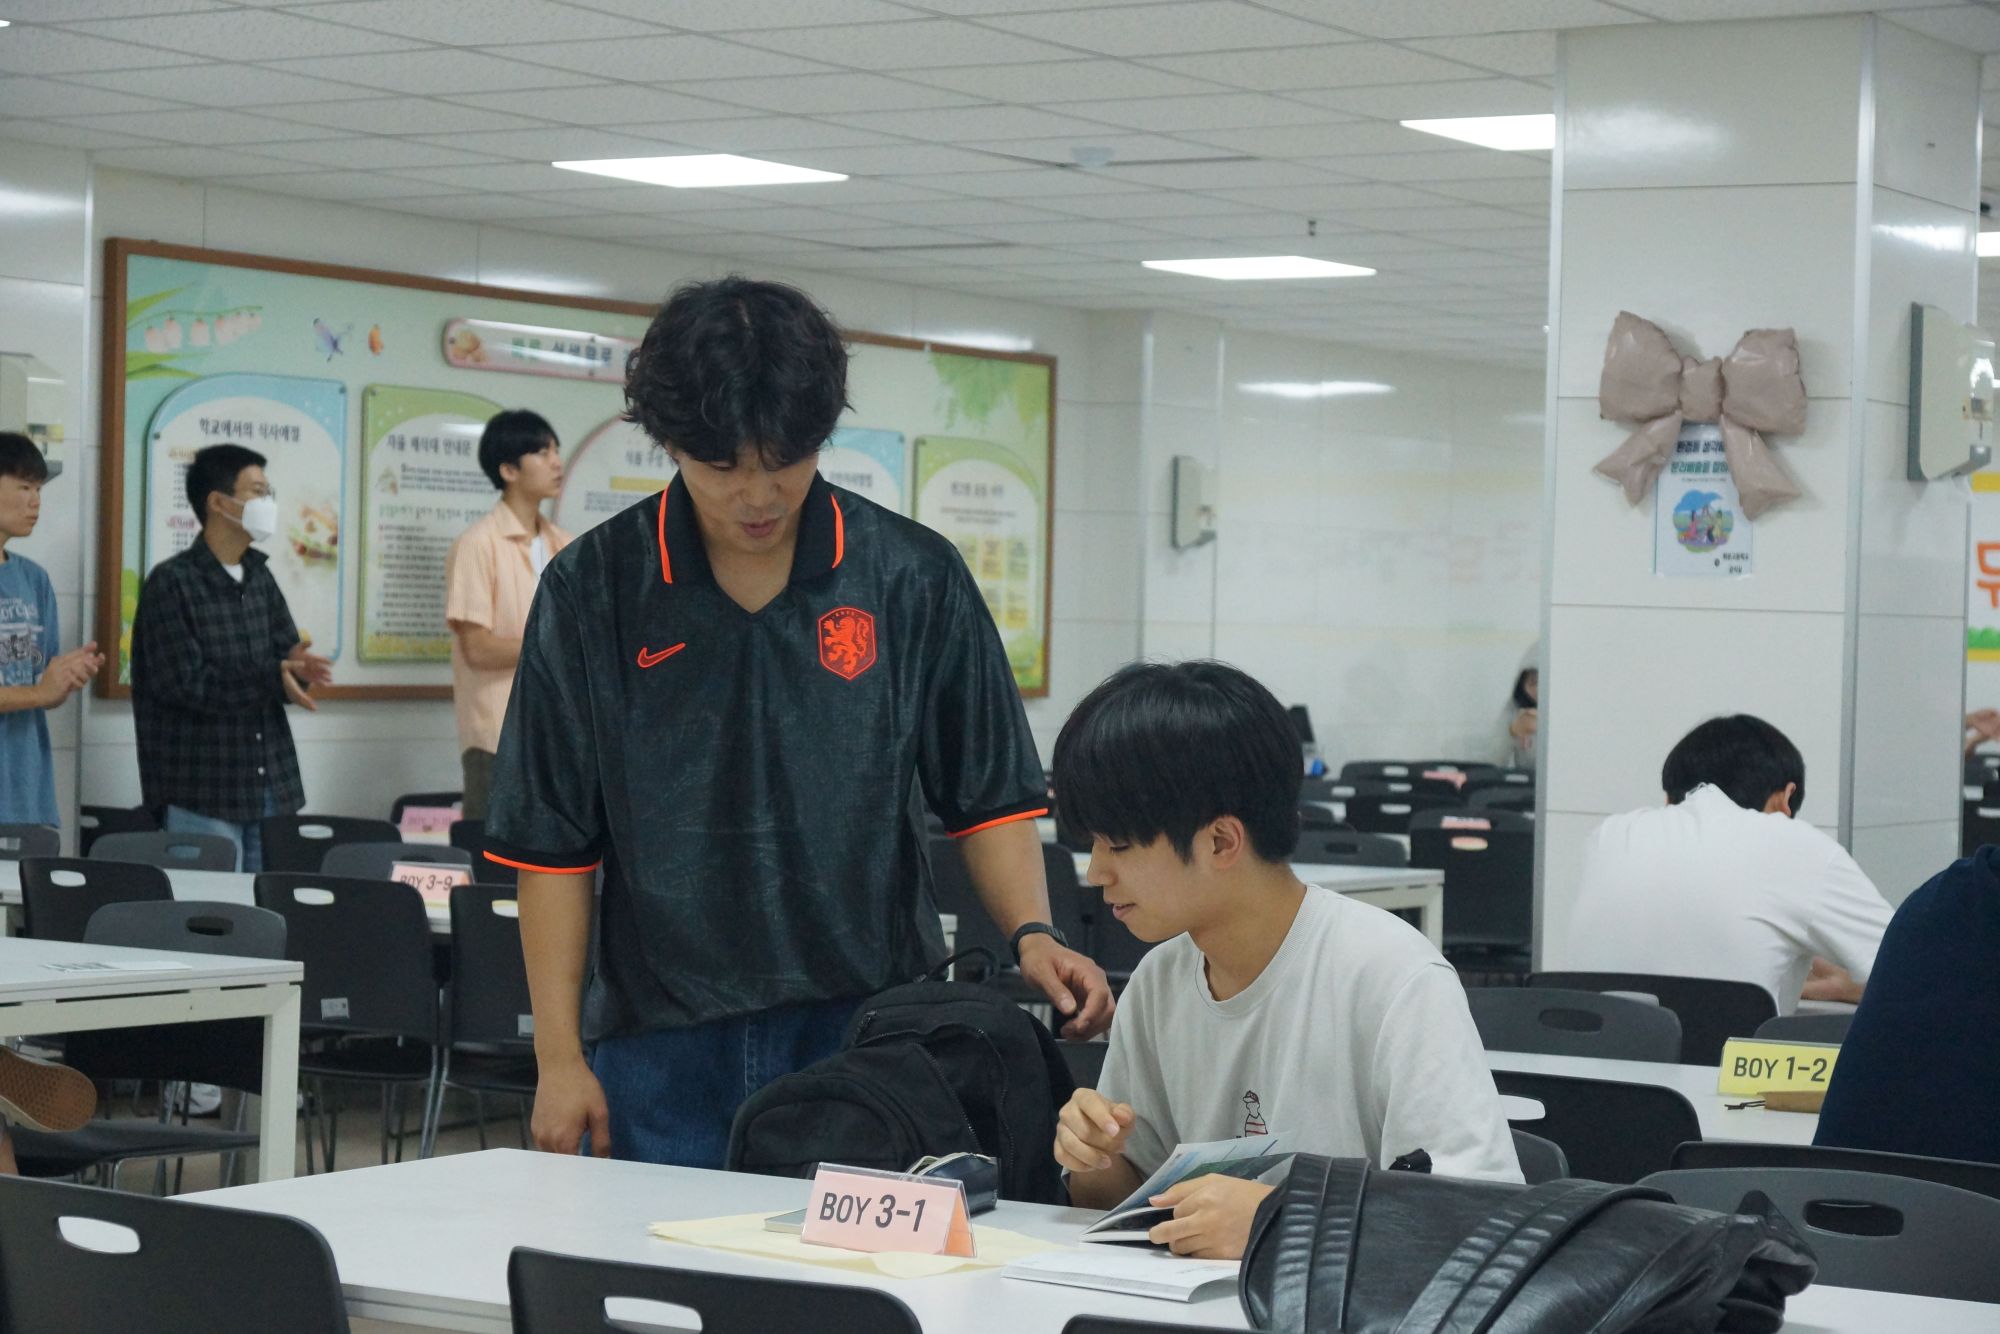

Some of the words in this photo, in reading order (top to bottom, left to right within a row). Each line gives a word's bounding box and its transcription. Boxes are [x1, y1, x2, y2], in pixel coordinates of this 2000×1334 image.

[199, 417, 254, 438] 학교에서의
[426, 874, 453, 891] 3-9
[1733, 1056, 1779, 1079] BOY
[1784, 1056, 1828, 1082] 1-2
[819, 1192, 872, 1225] BOY
[875, 1194, 926, 1232] 3-1
